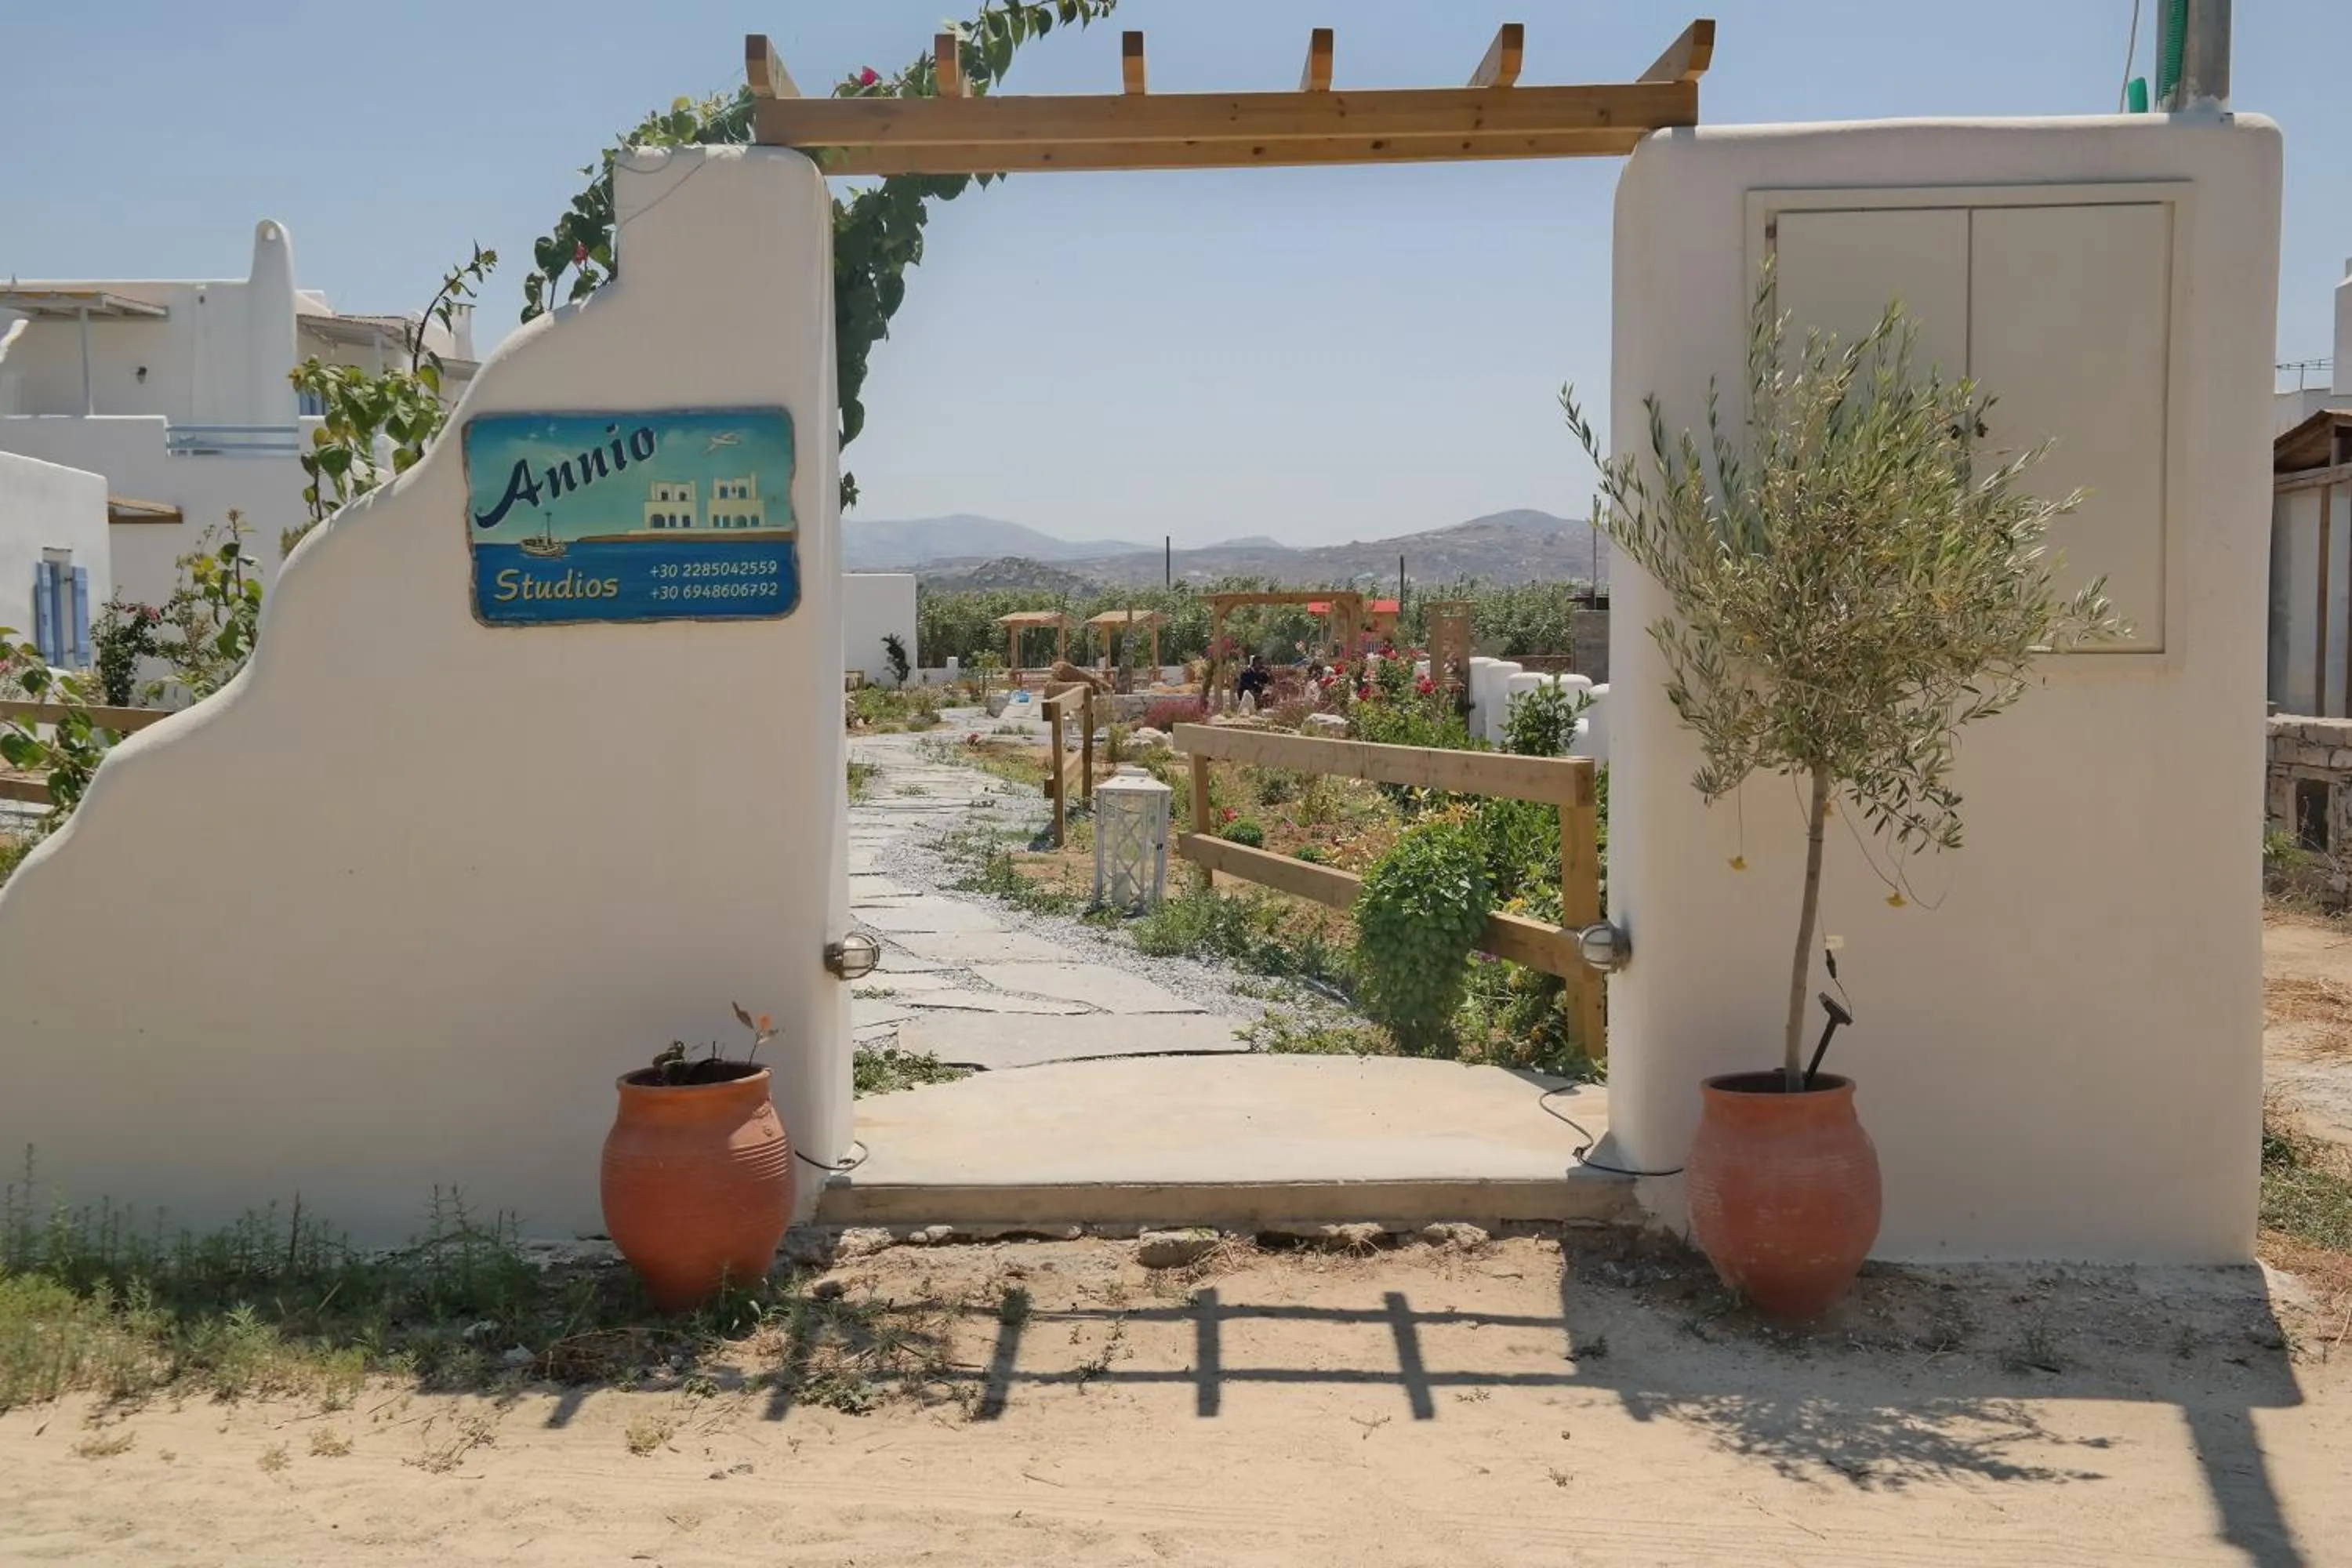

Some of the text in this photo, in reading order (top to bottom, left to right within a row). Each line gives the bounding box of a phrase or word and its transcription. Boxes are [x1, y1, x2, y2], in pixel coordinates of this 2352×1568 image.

[474, 423, 657, 529] Annio
[650, 560, 778, 577] +30 2285042559
[494, 568, 619, 601] Studios
[650, 583, 779, 601] +30 6948606792
